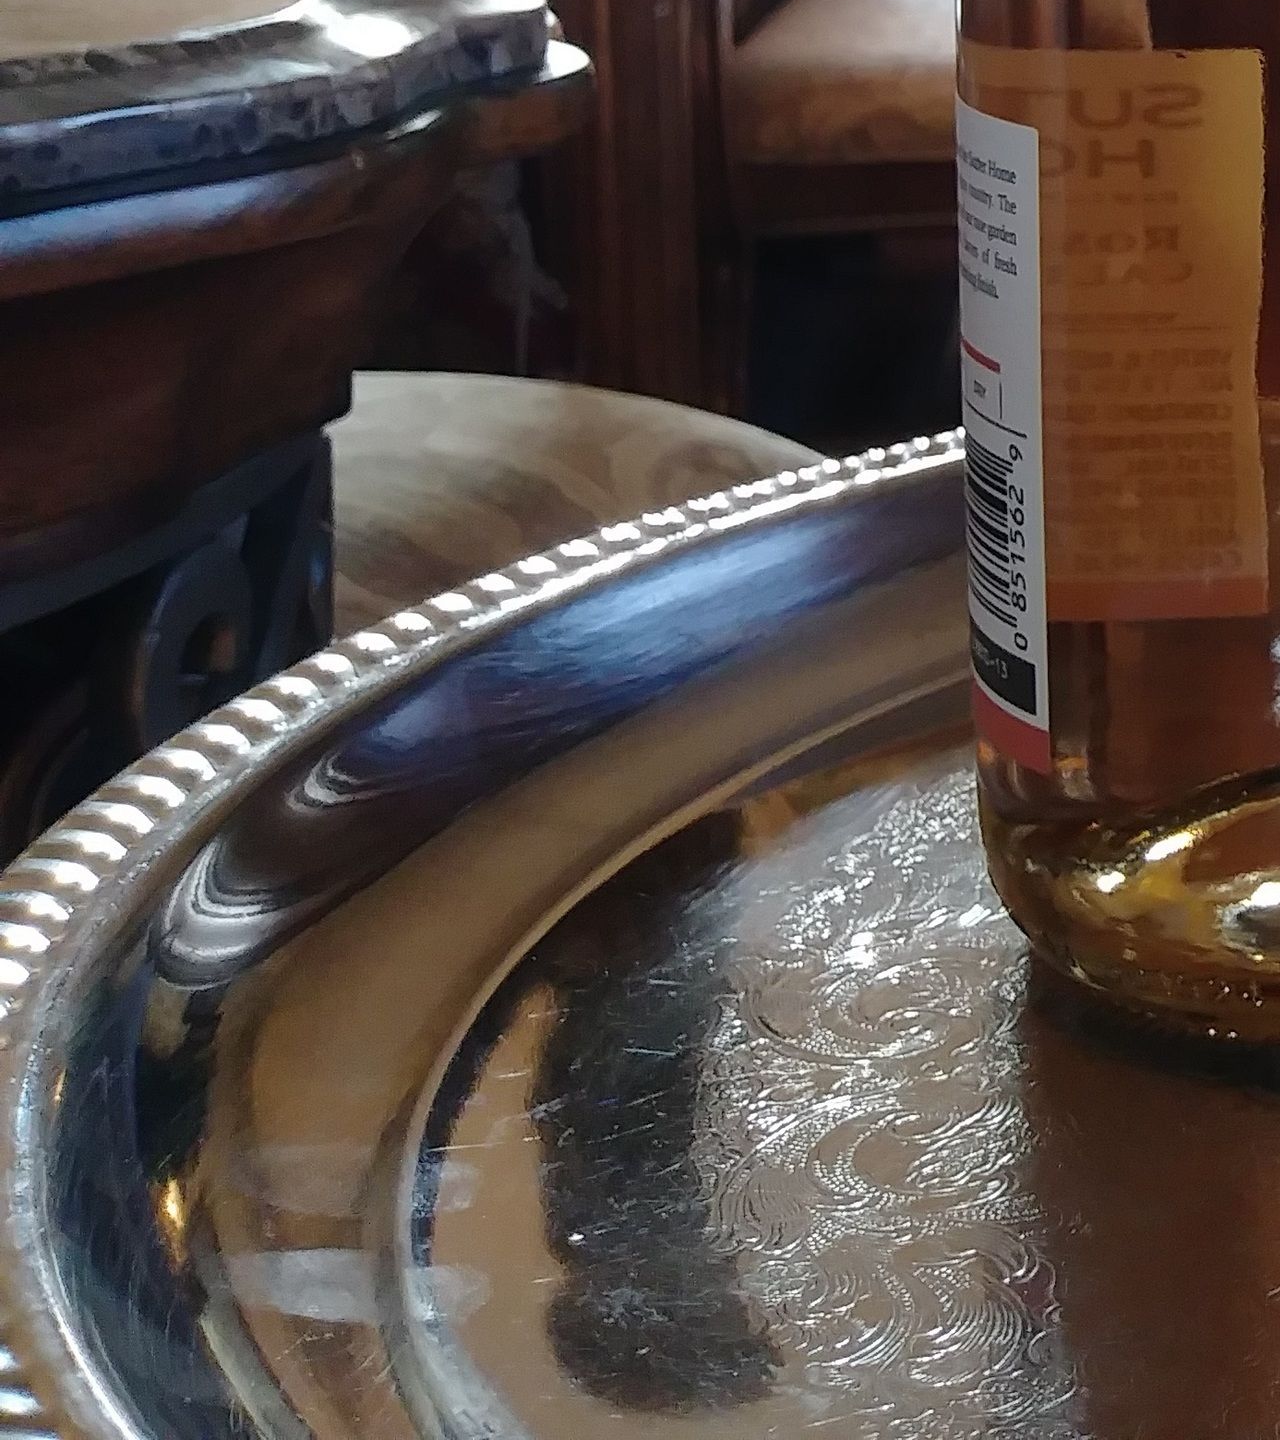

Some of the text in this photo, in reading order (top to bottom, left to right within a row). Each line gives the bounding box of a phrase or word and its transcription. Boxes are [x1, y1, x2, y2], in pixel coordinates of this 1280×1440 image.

[997, 194, 1017, 215] The
[1008, 485, 1028, 612] 851562
[1014, 631, 1029, 651] 0
